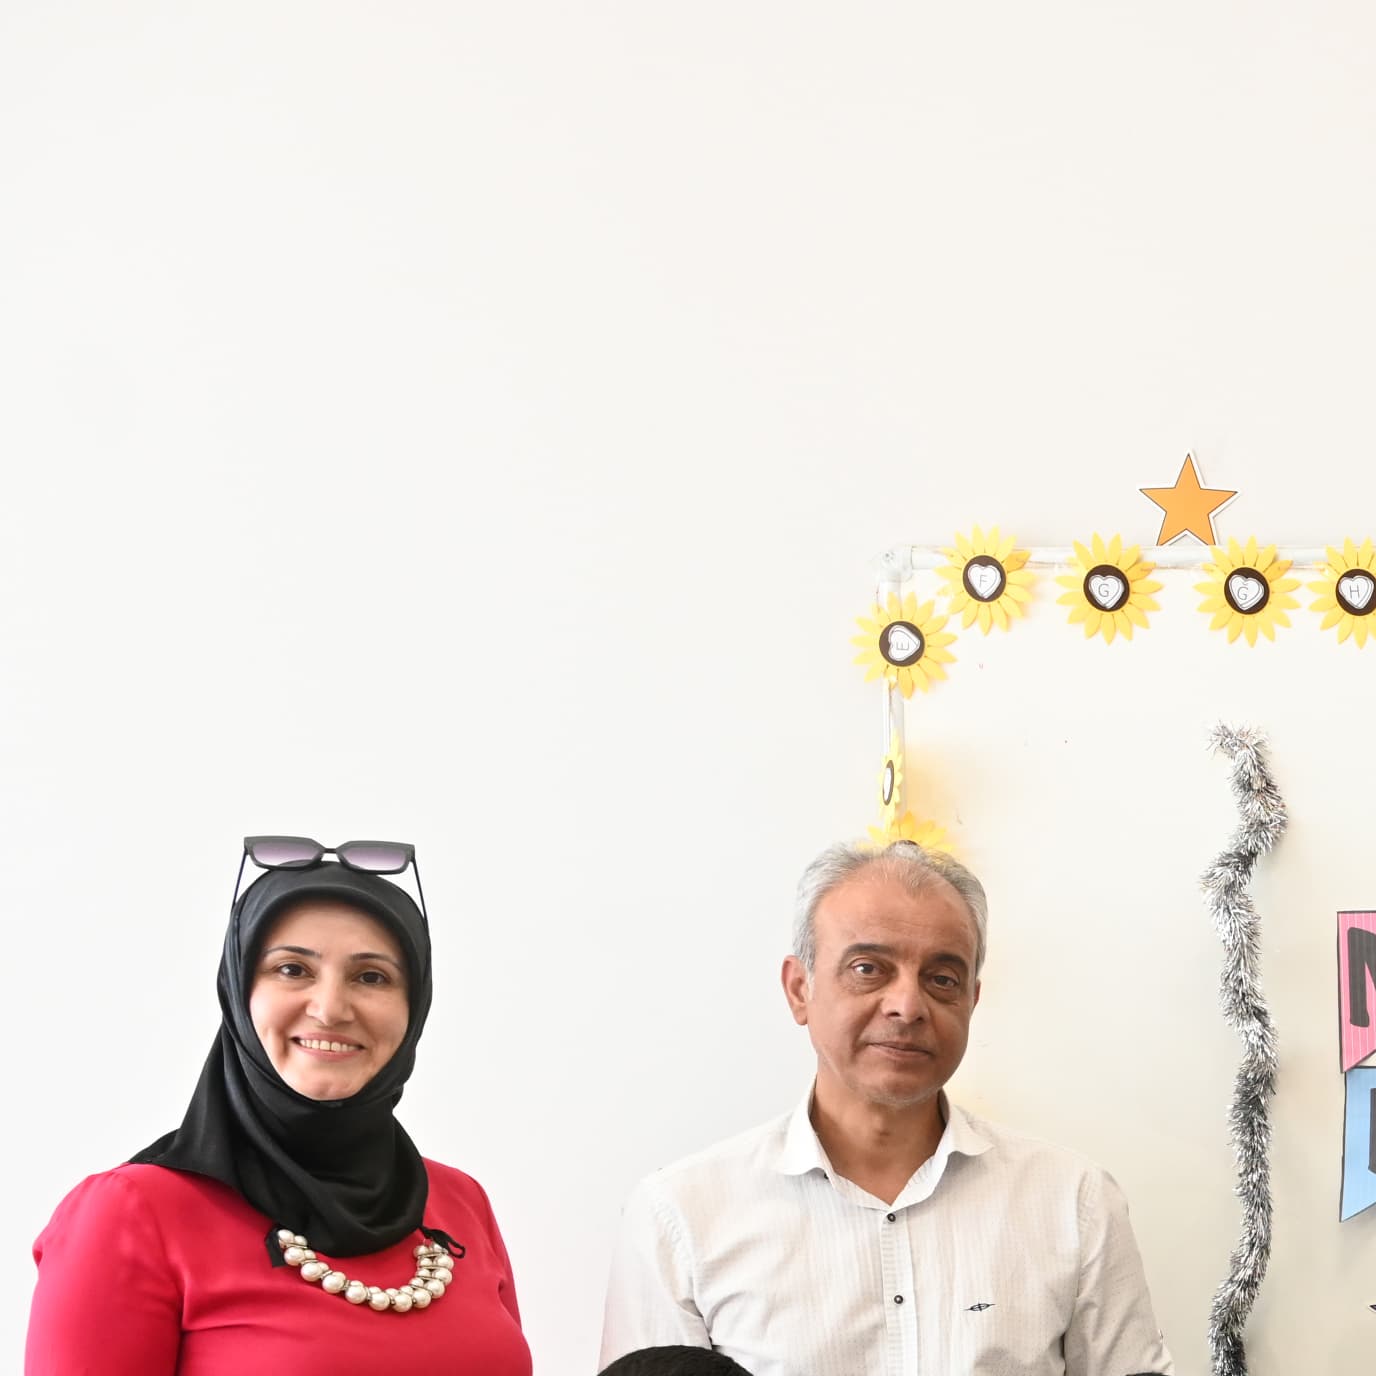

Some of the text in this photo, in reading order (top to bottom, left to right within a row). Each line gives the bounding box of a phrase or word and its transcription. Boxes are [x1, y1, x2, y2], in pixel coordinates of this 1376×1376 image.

[979, 574, 988, 587] F
[1098, 583, 1109, 597] G
[1349, 584, 1360, 599] H
